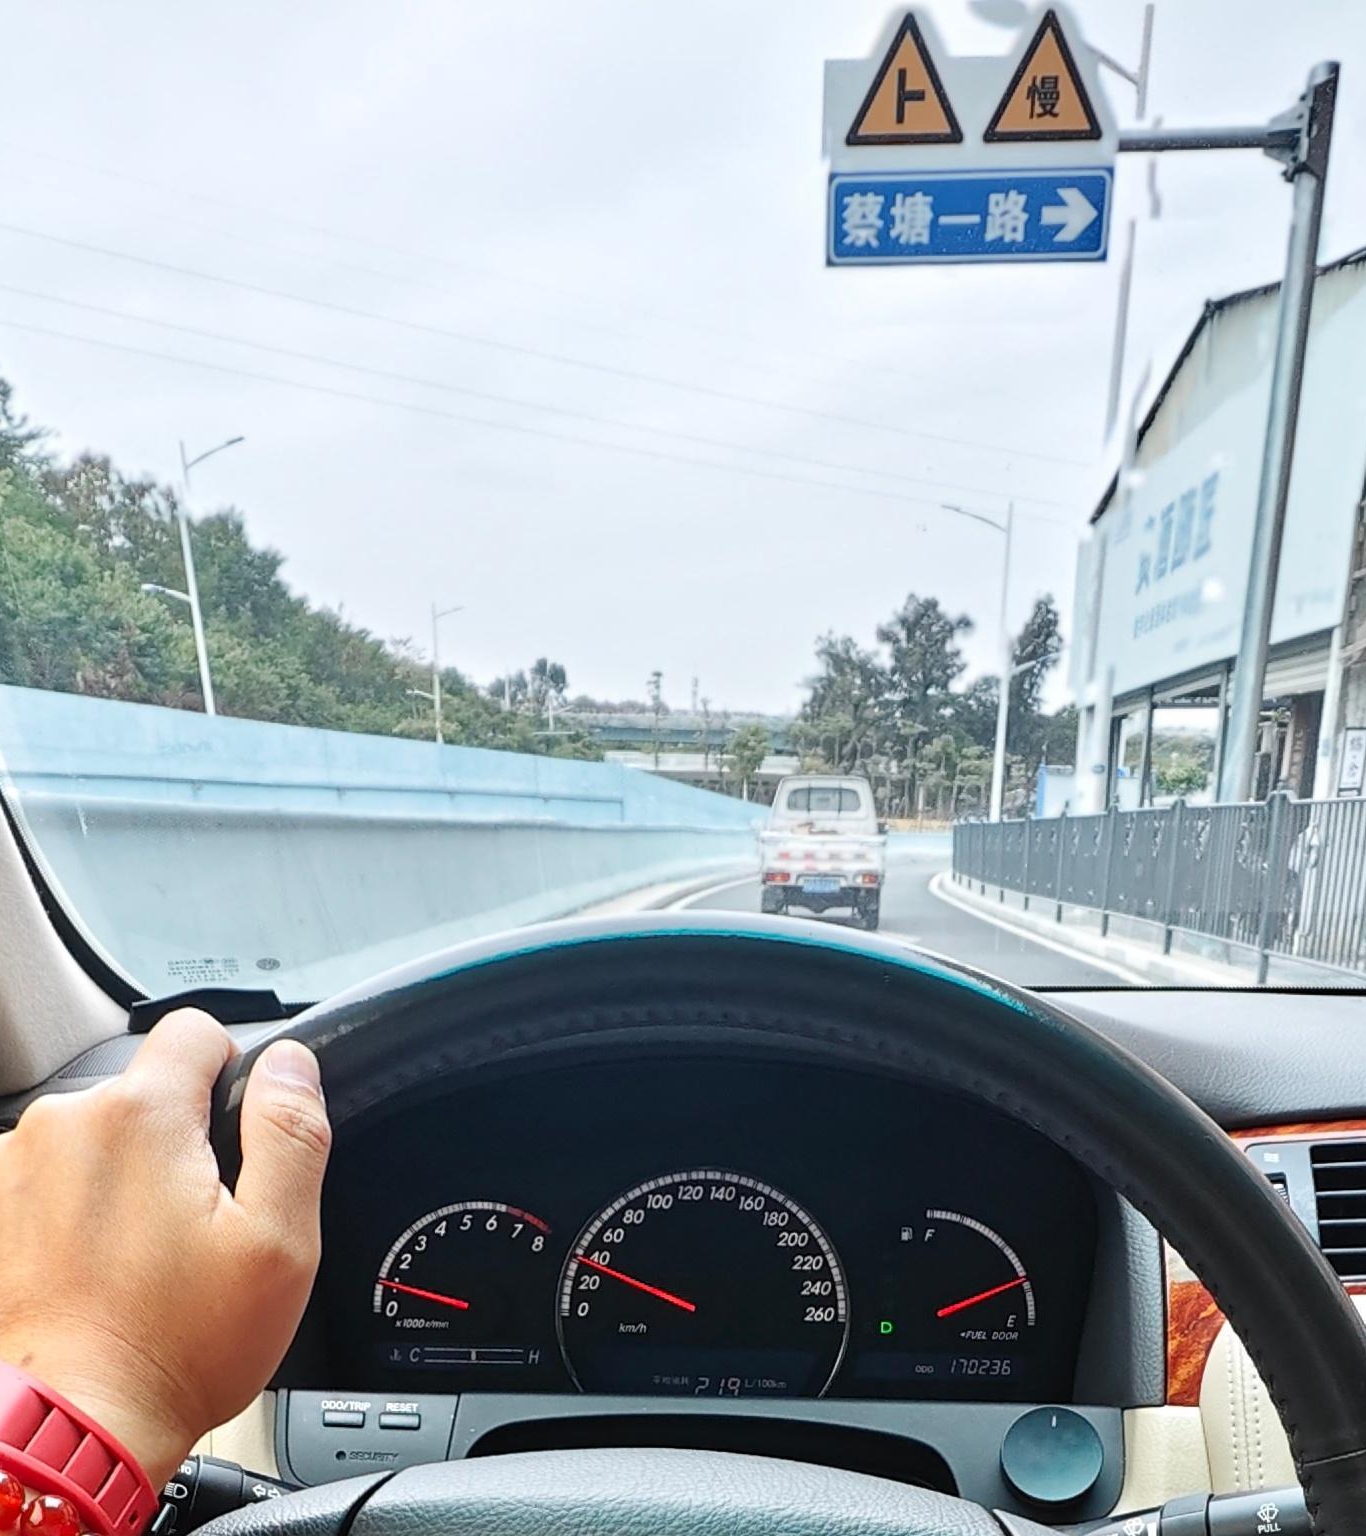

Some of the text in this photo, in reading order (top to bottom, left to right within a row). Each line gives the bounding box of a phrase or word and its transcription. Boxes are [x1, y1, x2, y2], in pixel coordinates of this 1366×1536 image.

[1026, 75, 1060, 120] 慢
[842, 189, 1029, 248] 蔡塘一路
[677, 1185, 704, 1201] 120
[709, 1186, 736, 1201] 140
[646, 1194, 673, 1210] 100
[738, 1196, 765, 1211] 160
[460, 1215, 473, 1231] 5
[485, 1215, 498, 1231] 6
[623, 1209, 645, 1225] 80
[763, 1211, 789, 1227] 180
[434, 1220, 448, 1237] 4
[511, 1223, 524, 1239] 7
[602, 1228, 625, 1244] 60
[924, 1229, 935, 1243] F
[415, 1235, 428, 1251] 3
[531, 1236, 544, 1252] 8
[777, 1231, 809, 1247] 200
[399, 1253, 412, 1269] 2
[589, 1251, 611, 1266] 40
[791, 1255, 823, 1271] 220
[578, 1275, 600, 1290] 20
[801, 1280, 832, 1296] 240
[386, 1301, 398, 1317] 0
[577, 1302, 589, 1317] 0
[804, 1306, 835, 1322] 260
[619, 1322, 647, 1334] km/h
[880, 1321, 893, 1334] D
[1006, 1315, 1016, 1328] E
[965, 1331, 1018, 1341] FUEL DOOR
[409, 1347, 422, 1362] C
[528, 1349, 540, 1364] H
[915, 1358, 1011, 1376] ODO 170236
[321, 1400, 419, 1412] ODO/TRIP RESET
[348, 1450, 399, 1463] SECURITY
[1257, 1522, 1282, 1534] PULL
